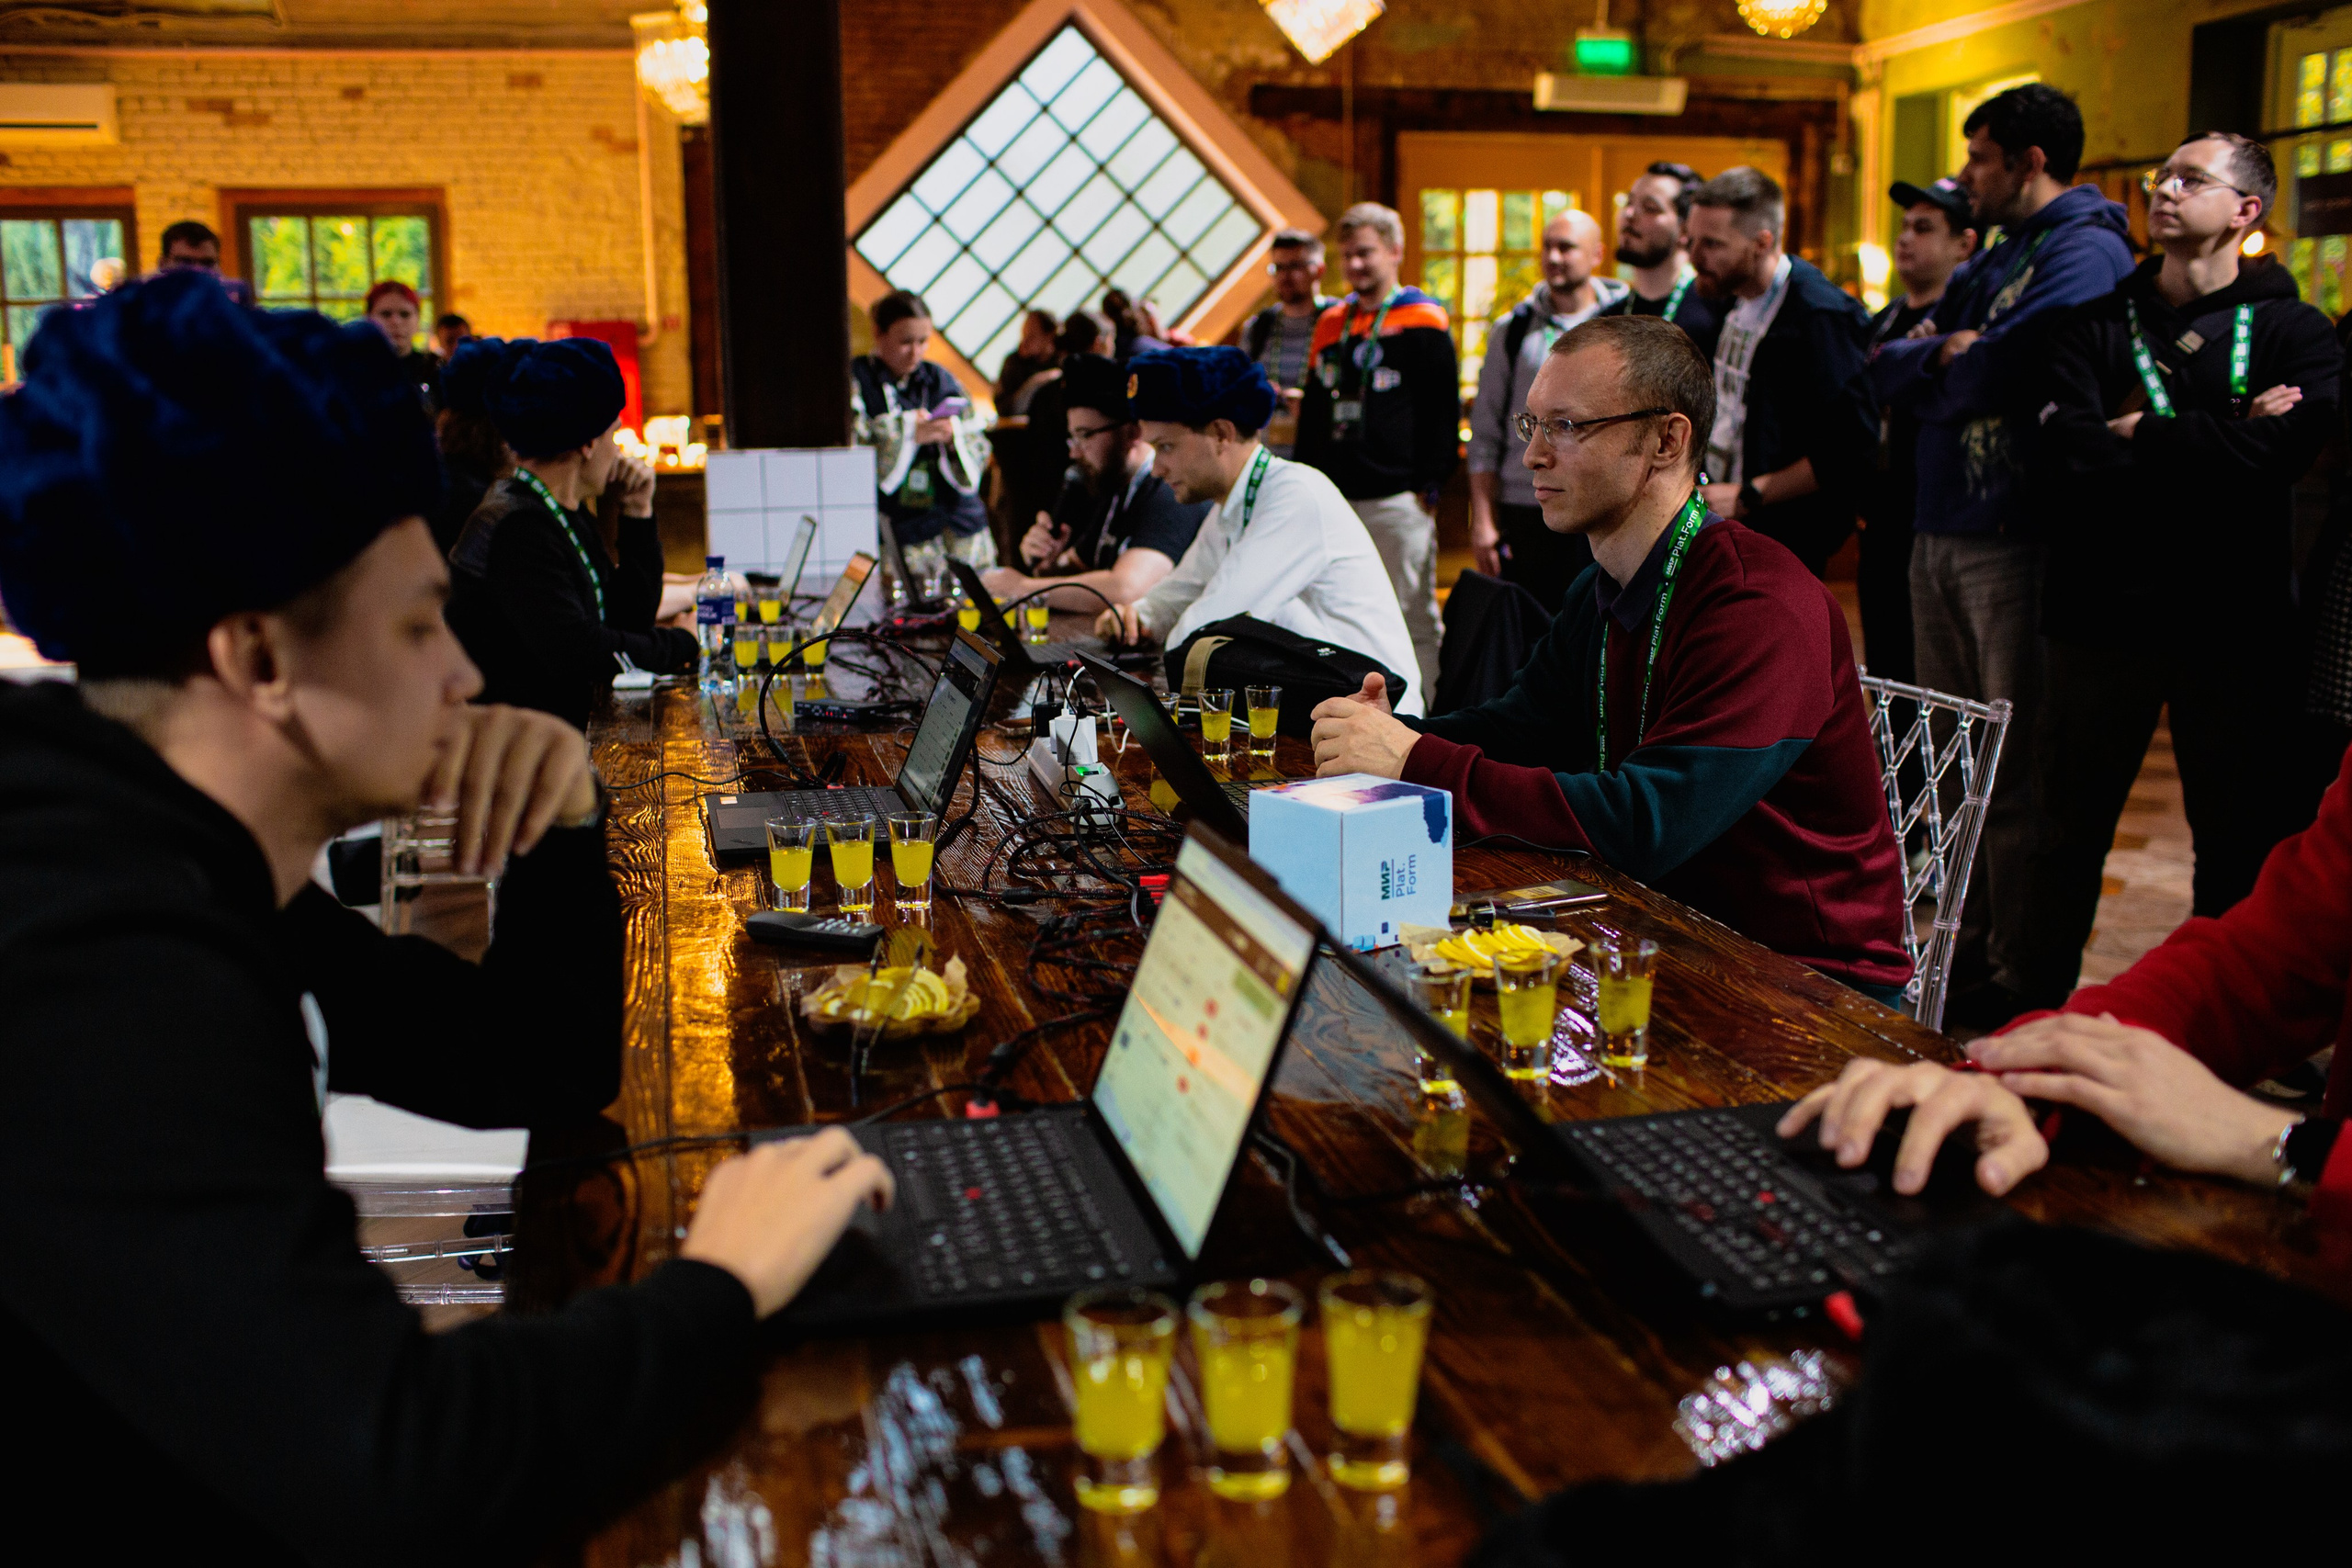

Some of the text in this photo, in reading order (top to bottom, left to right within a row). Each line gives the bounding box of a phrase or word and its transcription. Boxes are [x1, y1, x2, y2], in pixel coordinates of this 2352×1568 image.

[1666, 509, 1700, 575] МИР Plat.Form
[1651, 592, 1668, 646] Plat.Form
[1381, 861, 1390, 900] МИР
[1396, 863, 1406, 897] Plat.
[1407, 854, 1416, 895] Form
